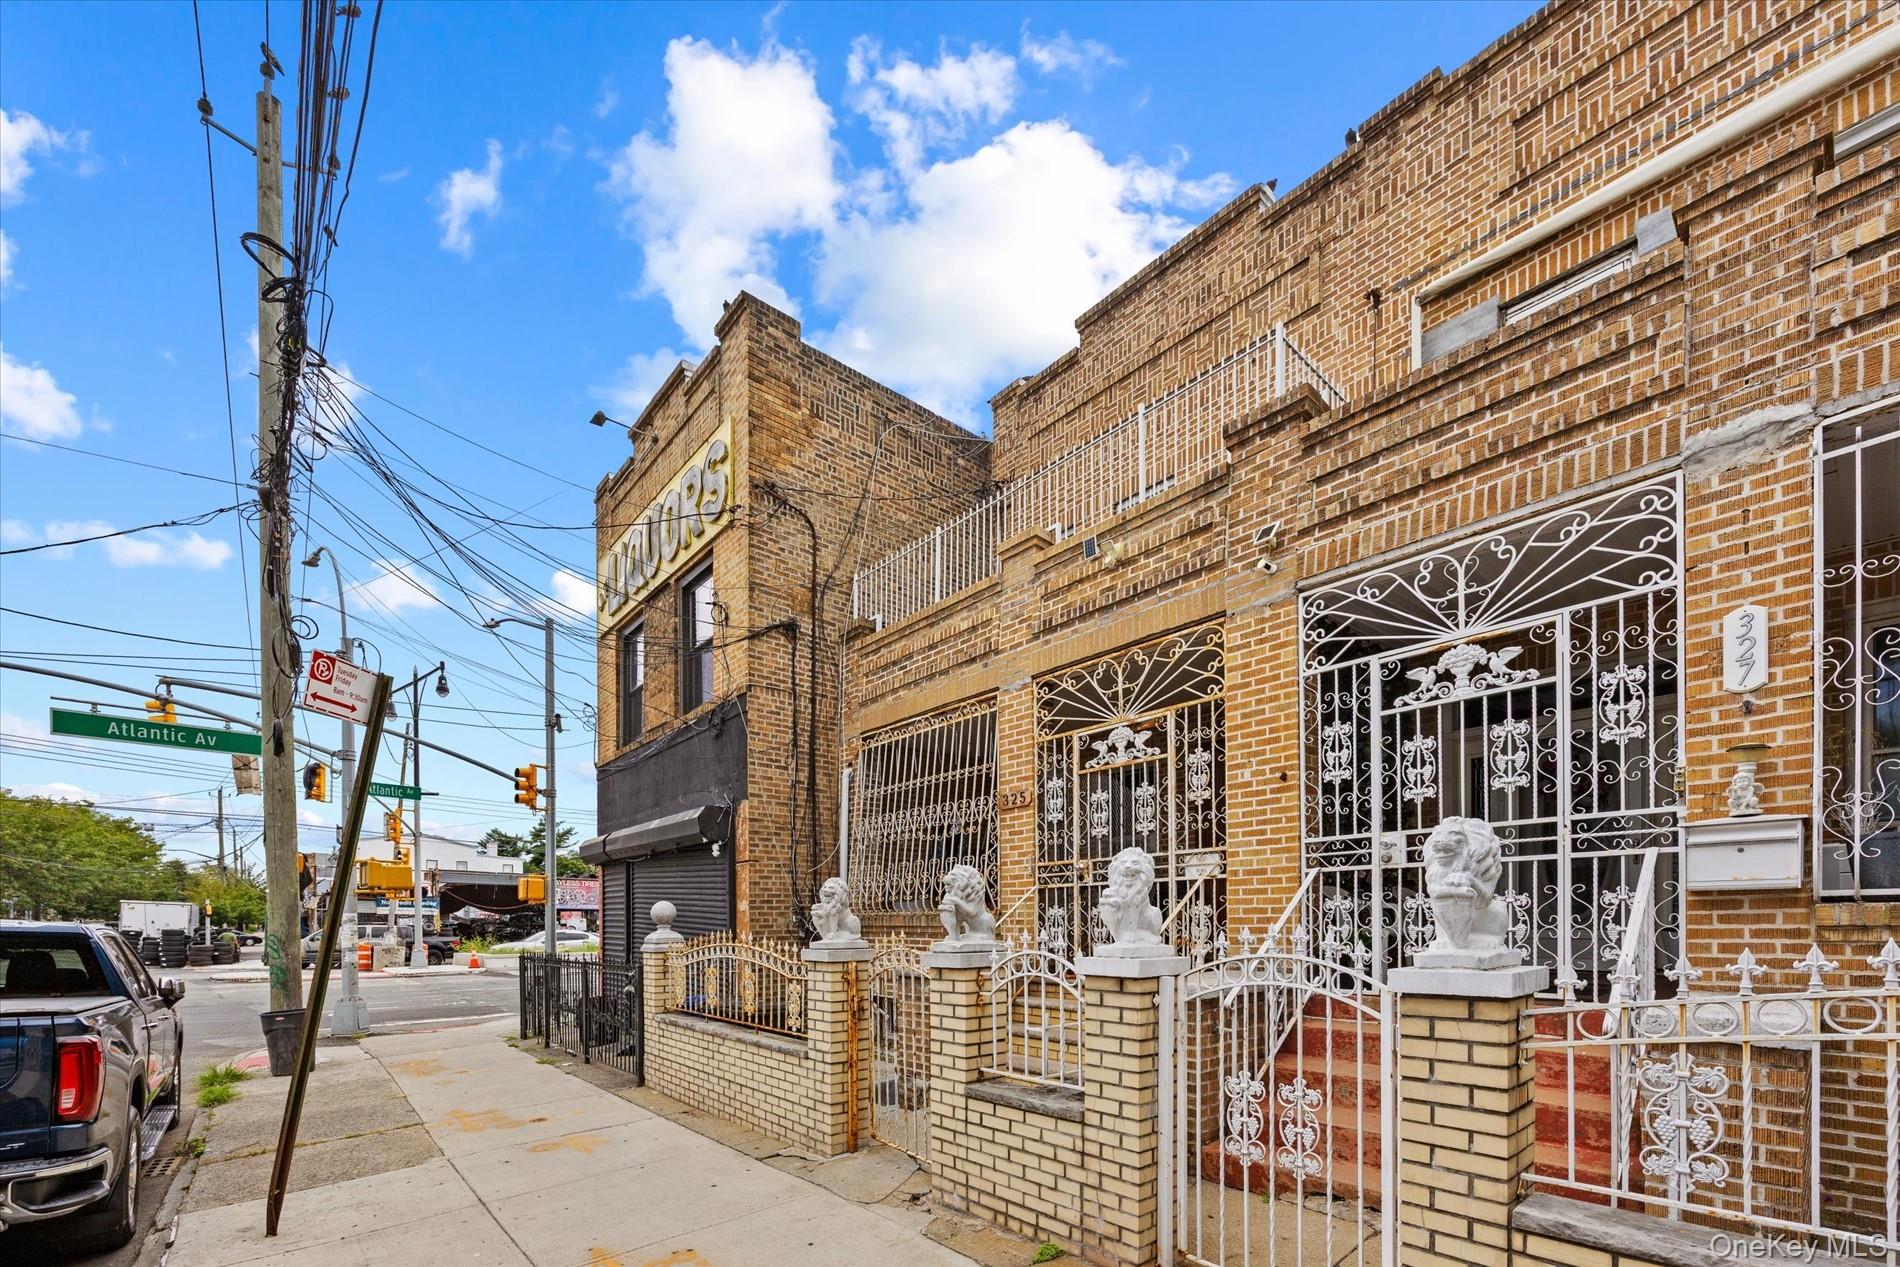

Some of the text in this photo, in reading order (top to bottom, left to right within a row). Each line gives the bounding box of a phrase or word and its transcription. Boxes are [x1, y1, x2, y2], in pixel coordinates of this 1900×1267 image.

[608, 439, 728, 616] LIQUORS
[1735, 612, 1757, 687] 327
[335, 674, 352, 688] Friday
[337, 666, 358, 681] Tuesday
[333, 686, 345, 697] 8am
[350, 691, 369, 705] 9:30am
[107, 721, 217, 746] Atlantic Av
[1002, 790, 1026, 807] 325
